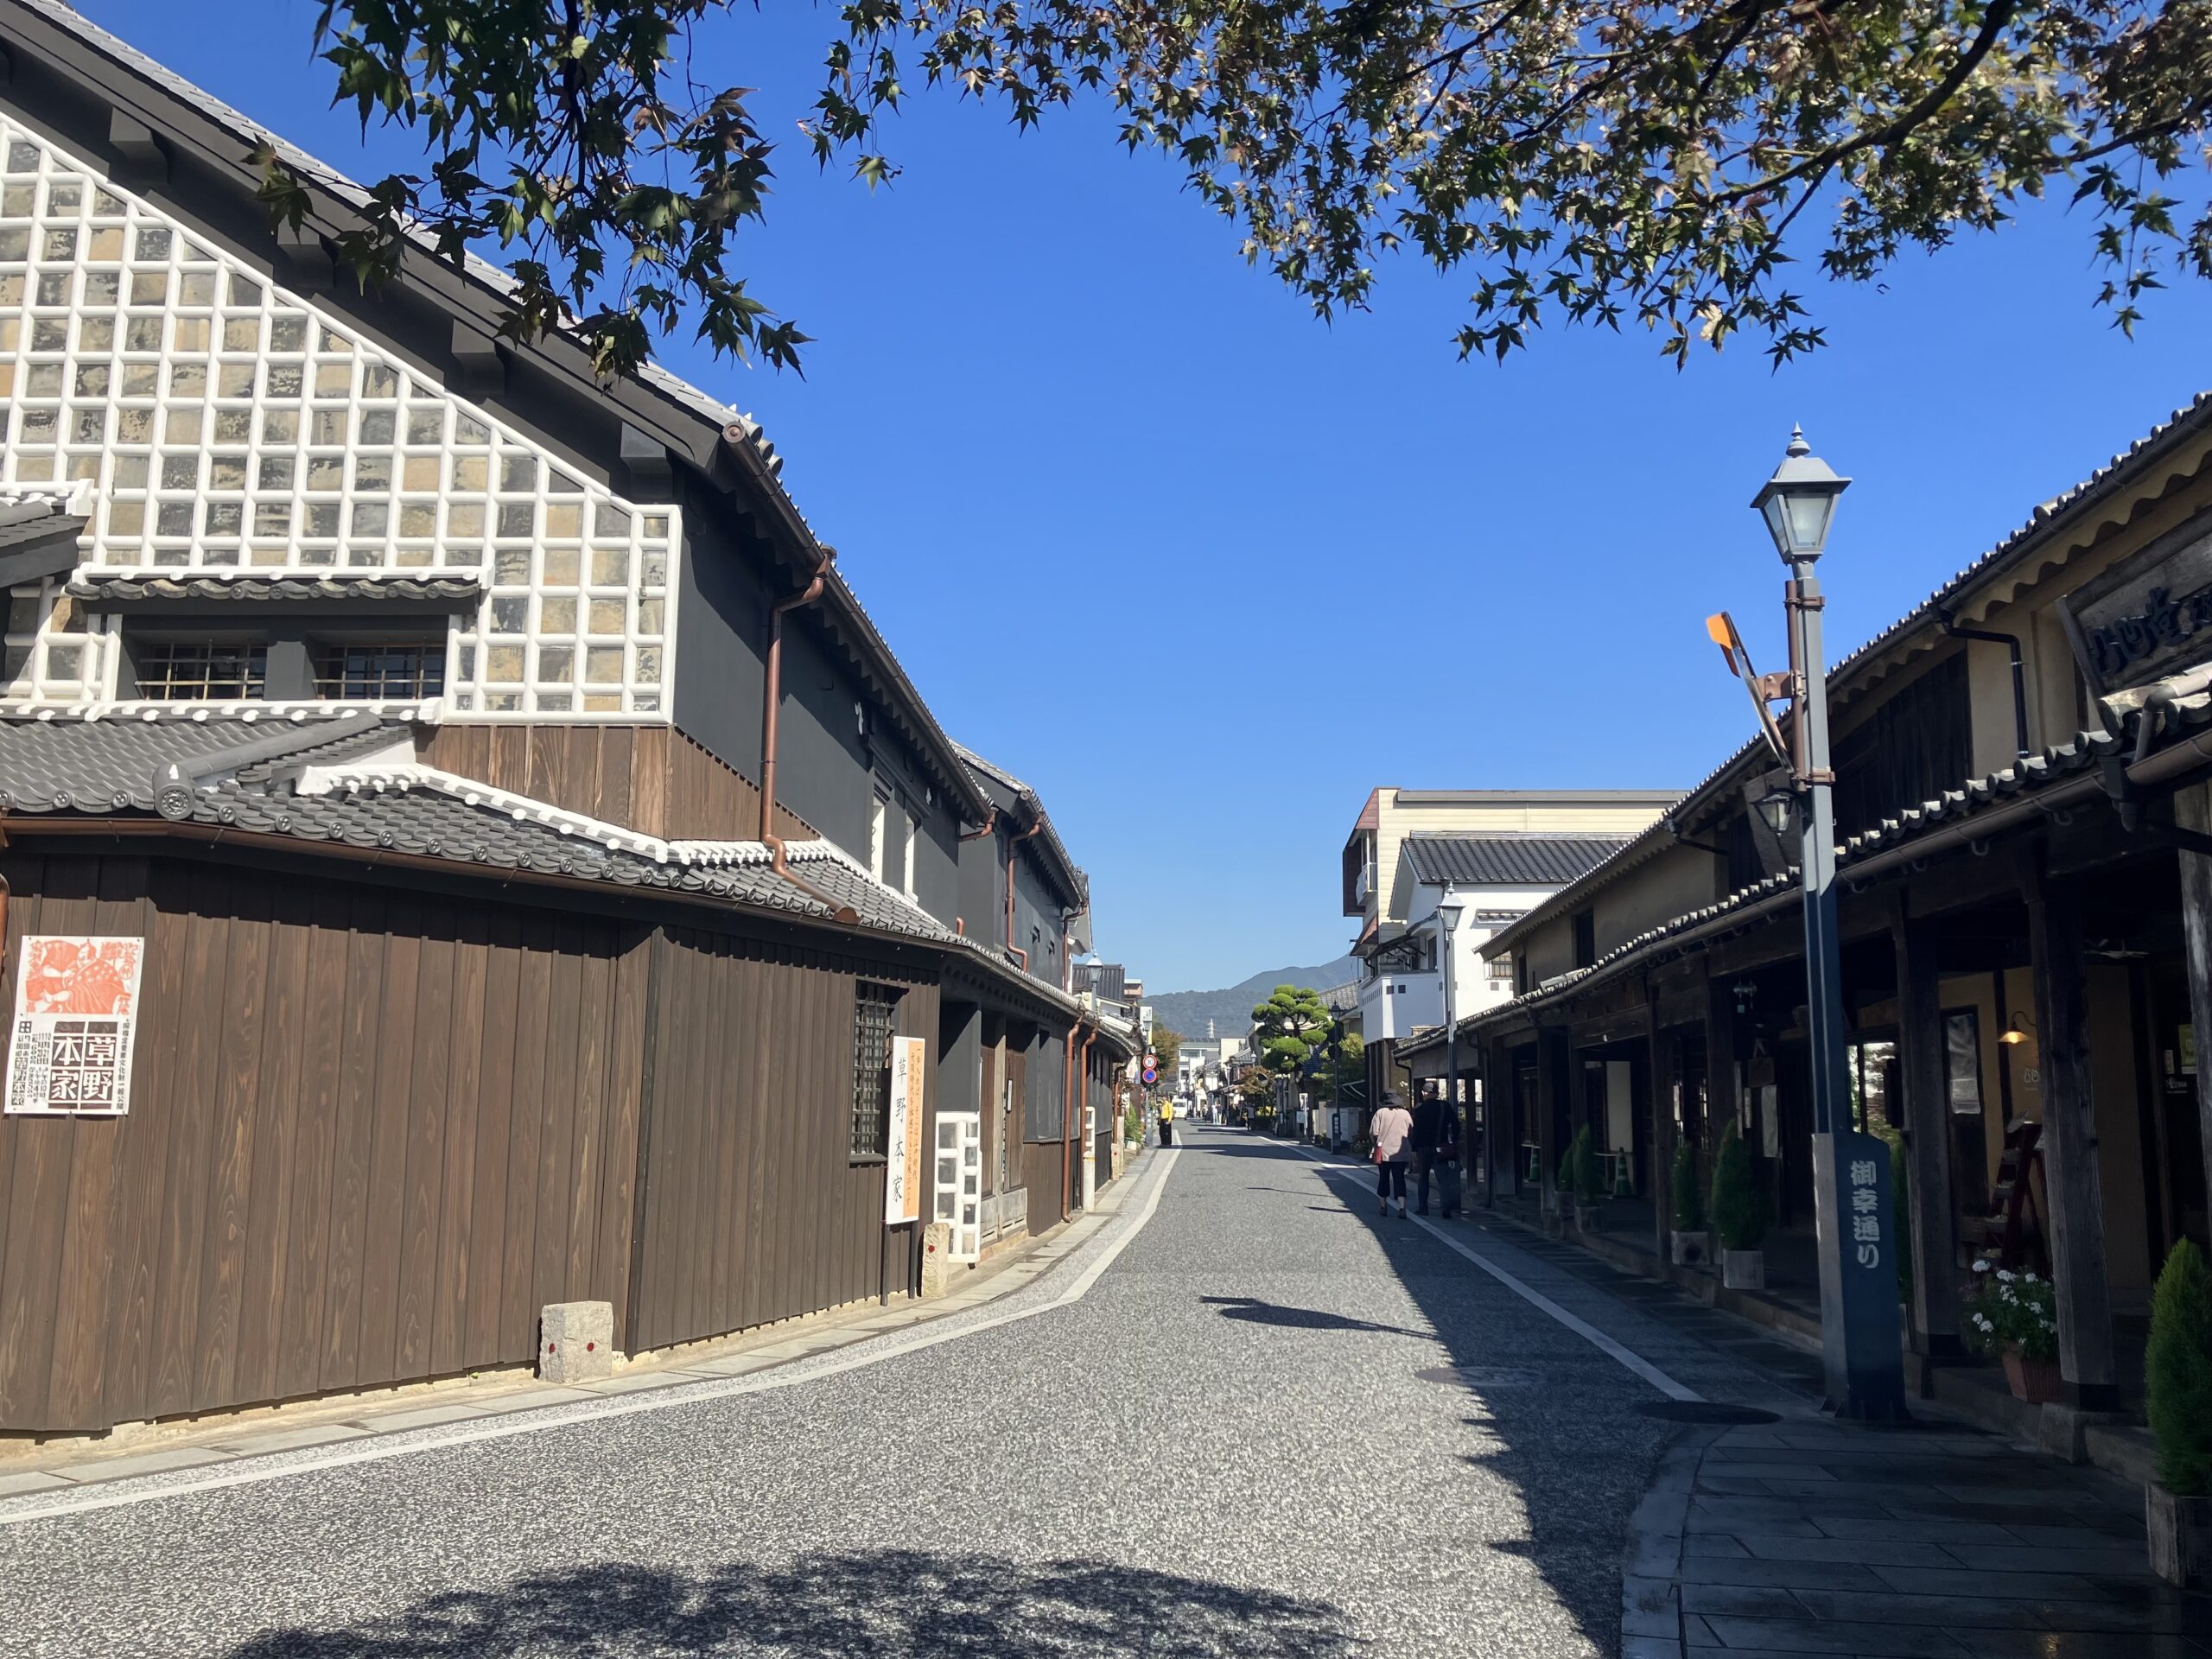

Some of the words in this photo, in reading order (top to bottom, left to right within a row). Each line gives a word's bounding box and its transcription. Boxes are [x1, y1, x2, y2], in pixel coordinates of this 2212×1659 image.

[893, 1058, 906, 1203] 草野本家
[1851, 1160, 1880, 1268] 御幸通り
